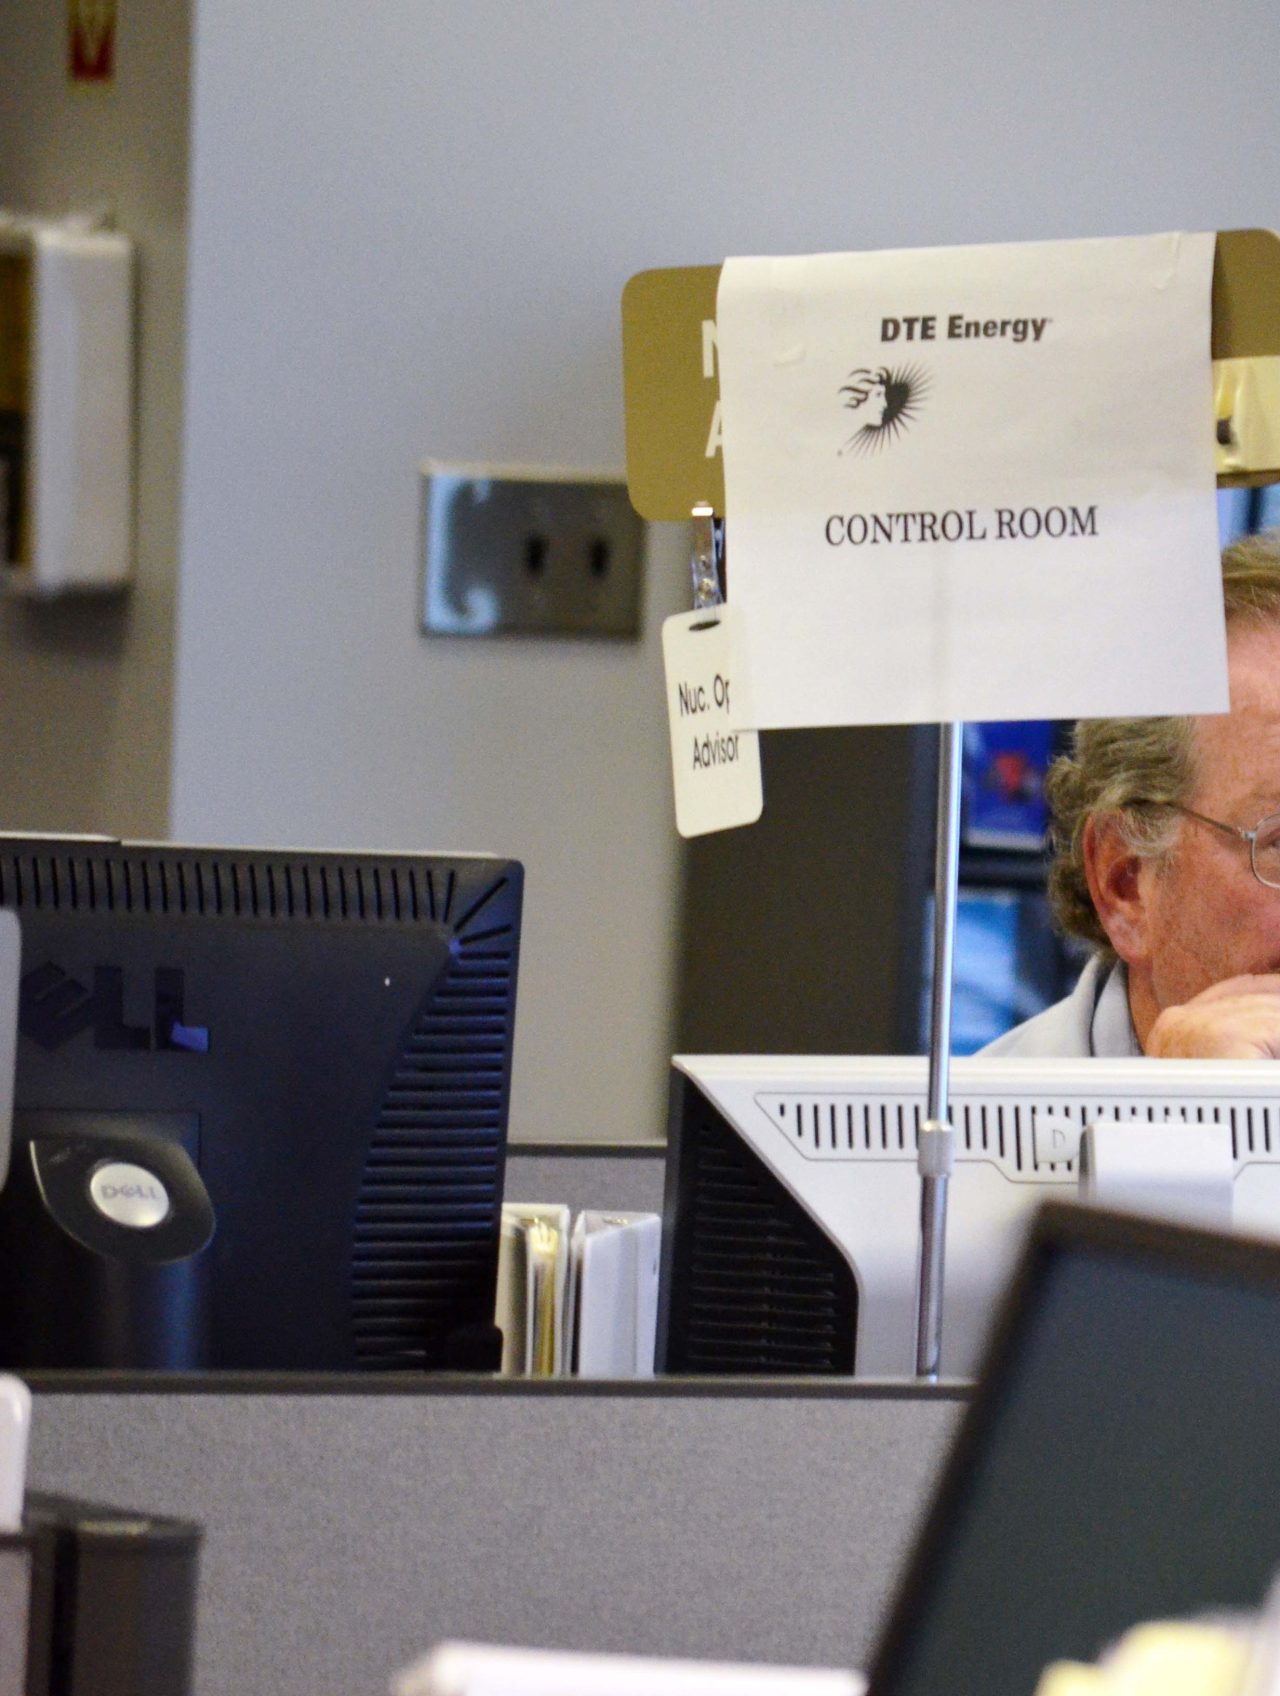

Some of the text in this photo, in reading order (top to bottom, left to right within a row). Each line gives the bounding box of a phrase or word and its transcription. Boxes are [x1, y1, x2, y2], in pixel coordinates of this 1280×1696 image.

[881, 314, 1048, 342] DTE Energy
[825, 506, 1098, 546] CONTROL ROOM
[678, 682, 710, 716] Nuc.
[692, 731, 739, 769] Advisor
[18, 960, 209, 1052] ELL
